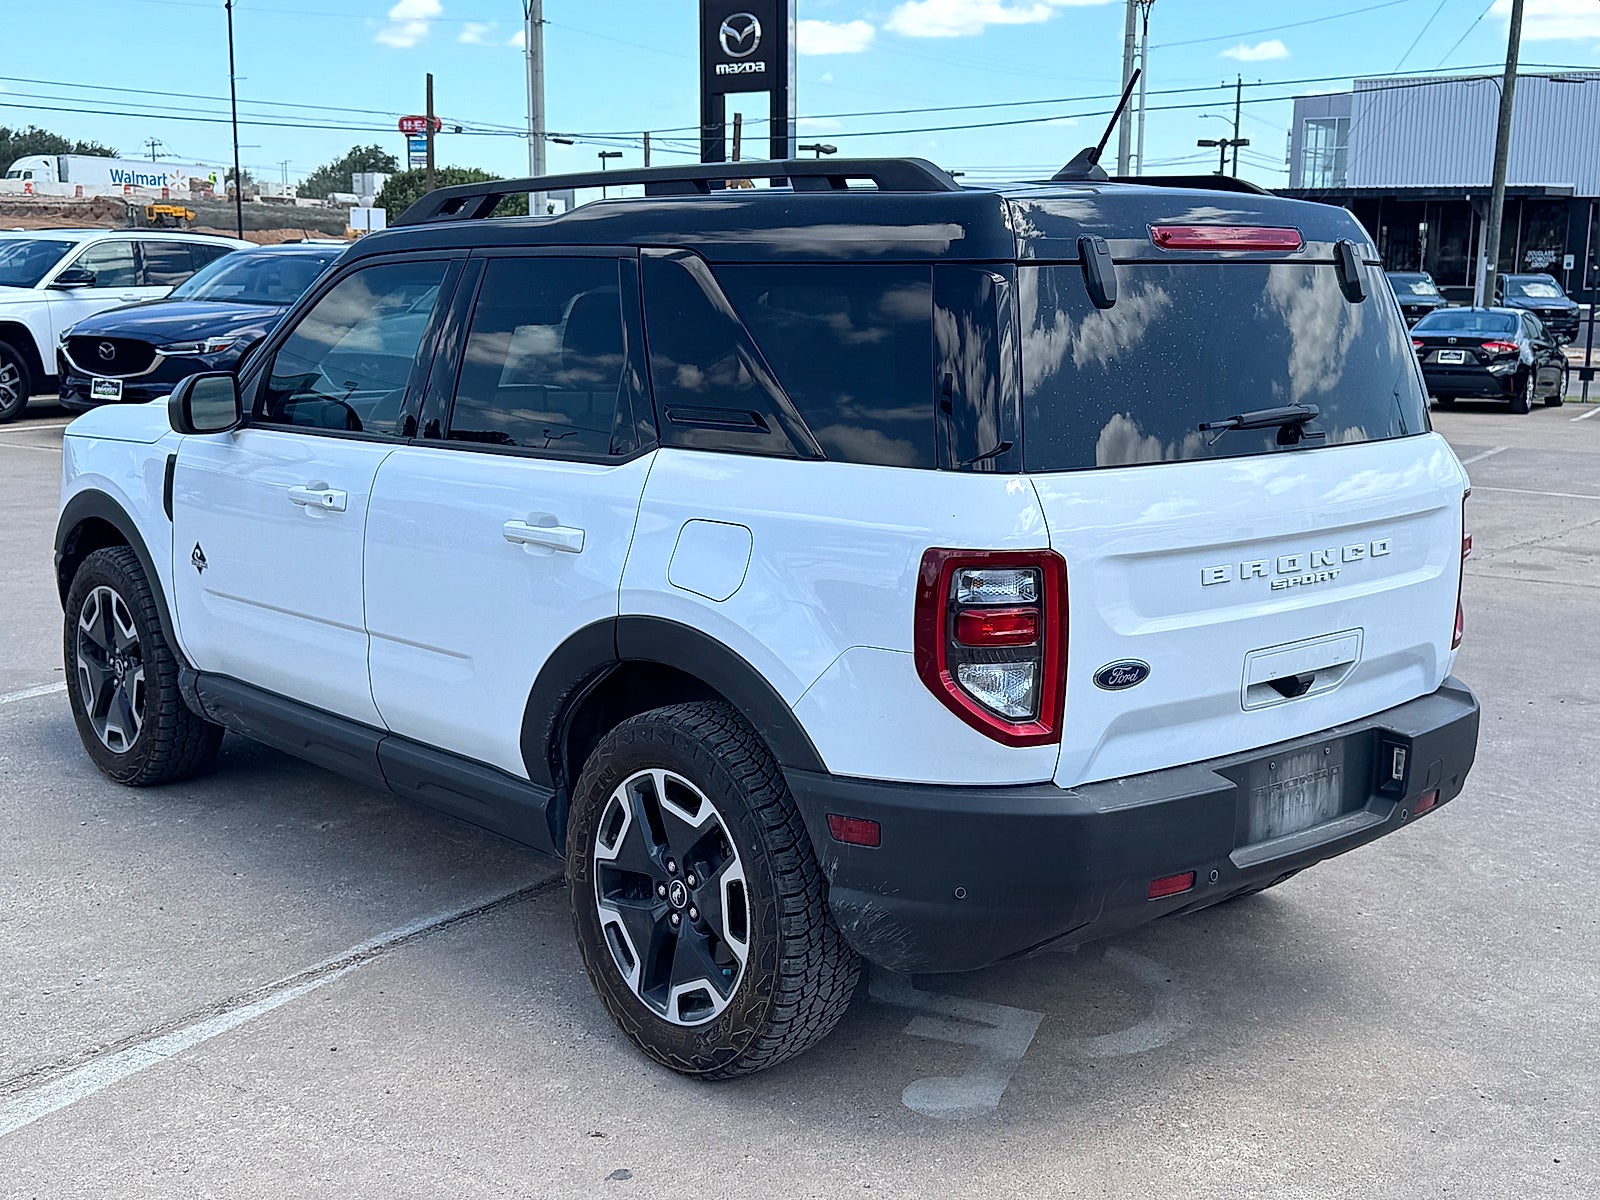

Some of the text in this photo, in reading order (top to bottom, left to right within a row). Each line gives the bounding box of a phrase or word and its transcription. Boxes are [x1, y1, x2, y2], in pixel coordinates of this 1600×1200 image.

[403, 120, 432, 130] H-E-
[110, 168, 168, 187] Walmart
[1201, 538, 1392, 586] BRONCO
[1271, 568, 1342, 590] SPORT
[1108, 666, 1140, 685] Ford
